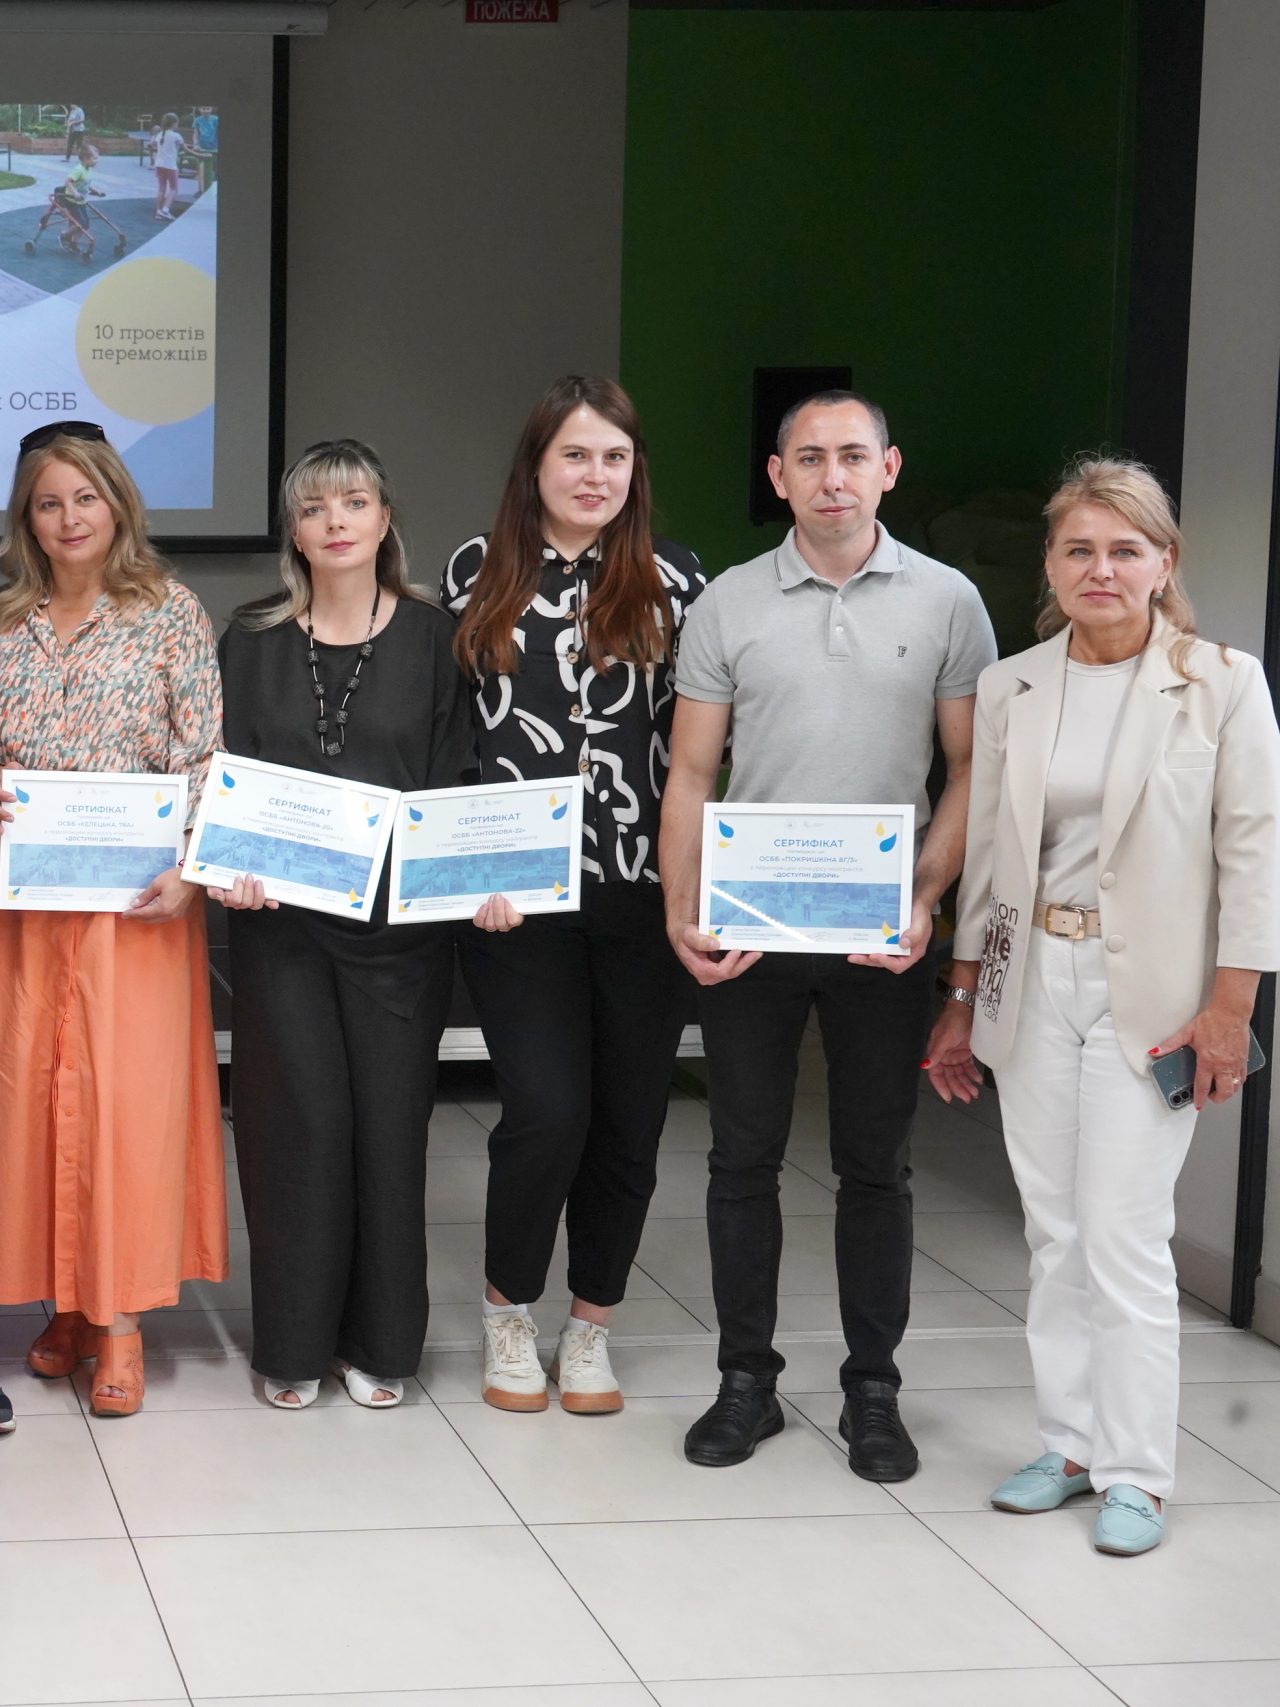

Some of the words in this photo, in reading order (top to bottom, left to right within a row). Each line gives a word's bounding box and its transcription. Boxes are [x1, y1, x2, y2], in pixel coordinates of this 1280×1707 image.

[473, 0, 550, 20] ПОЖЕЖА
[95, 324, 114, 340] 10
[120, 326, 205, 344] проєктів
[92, 347, 208, 365] переможців
[9, 392, 77, 410] ОСББ
[65, 805, 128, 813] СЕРТИФІКАТ
[268, 797, 332, 816] СЕРТИФІКАТ
[458, 813, 520, 825] СЕРТИФІКАТ
[774, 839, 844, 848] СЕРТИФІКАТ
